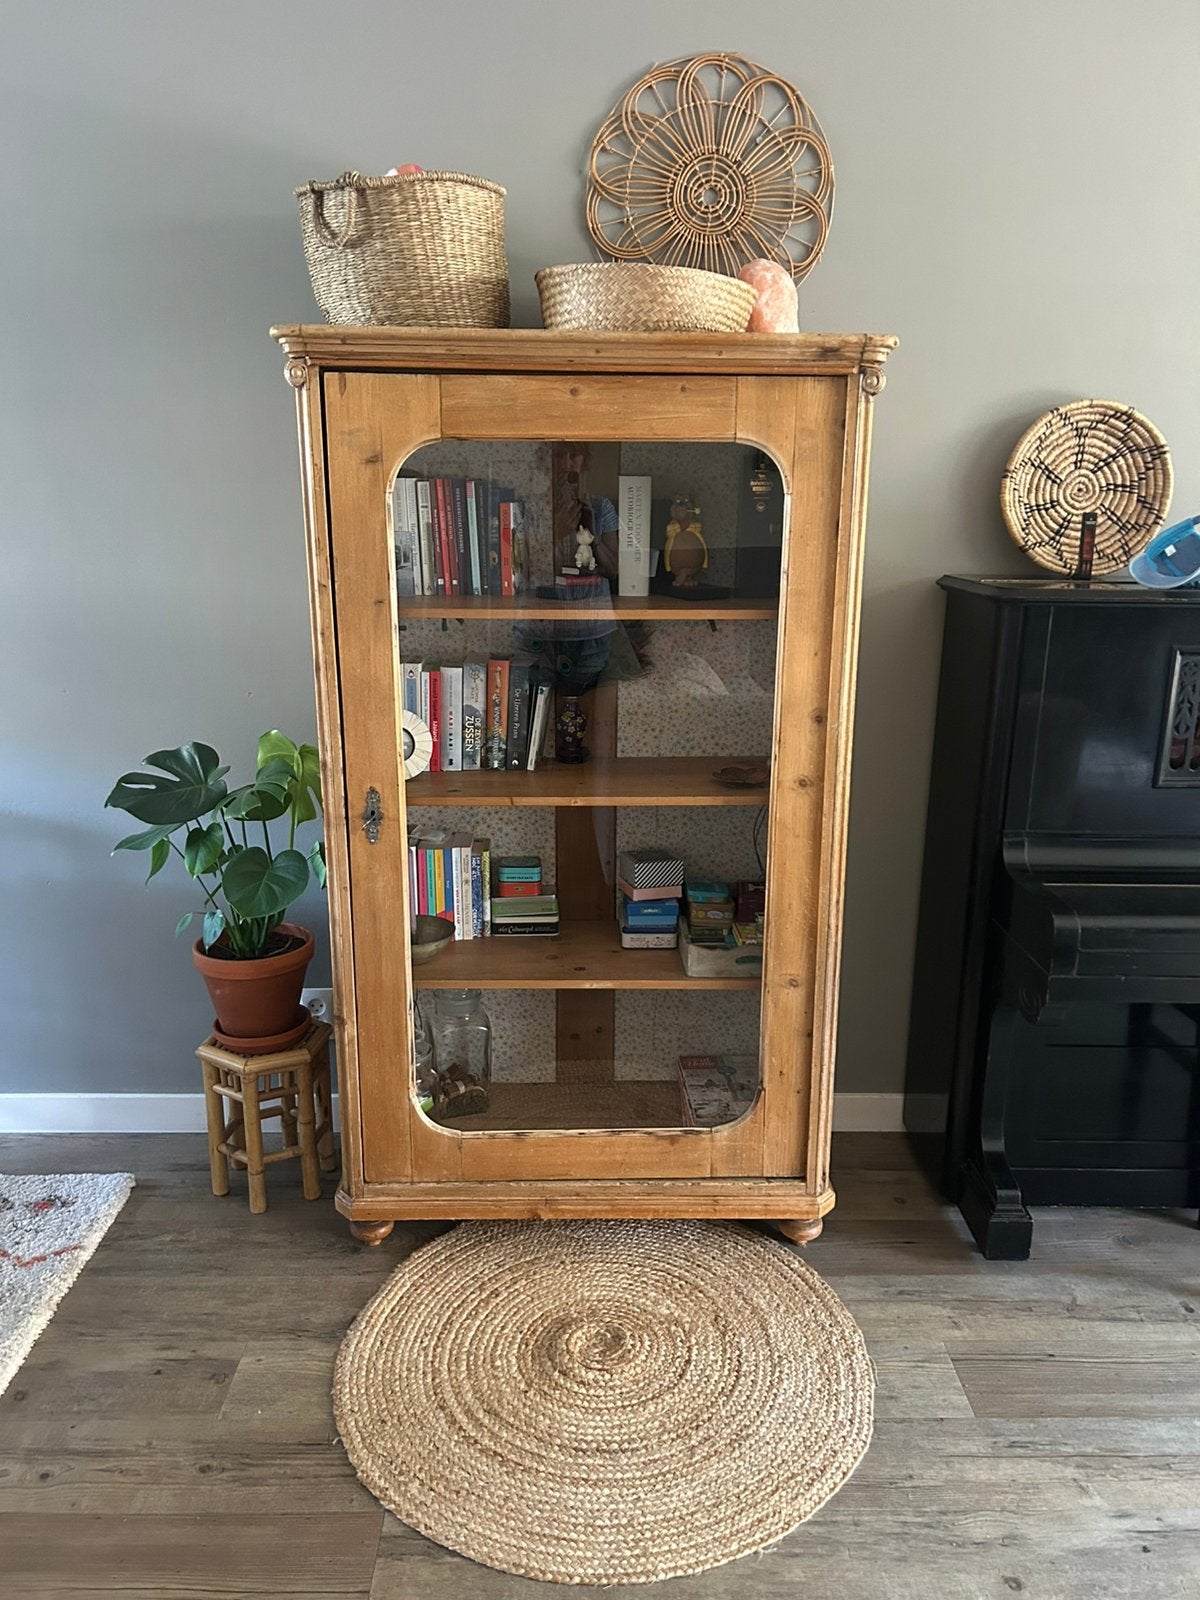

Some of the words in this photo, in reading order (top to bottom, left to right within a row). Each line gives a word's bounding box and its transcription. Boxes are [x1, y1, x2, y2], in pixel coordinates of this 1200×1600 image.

[514, 688, 521, 697] De
[475, 718, 481, 726] DE
[465, 715, 473, 752] ZUSSEN
